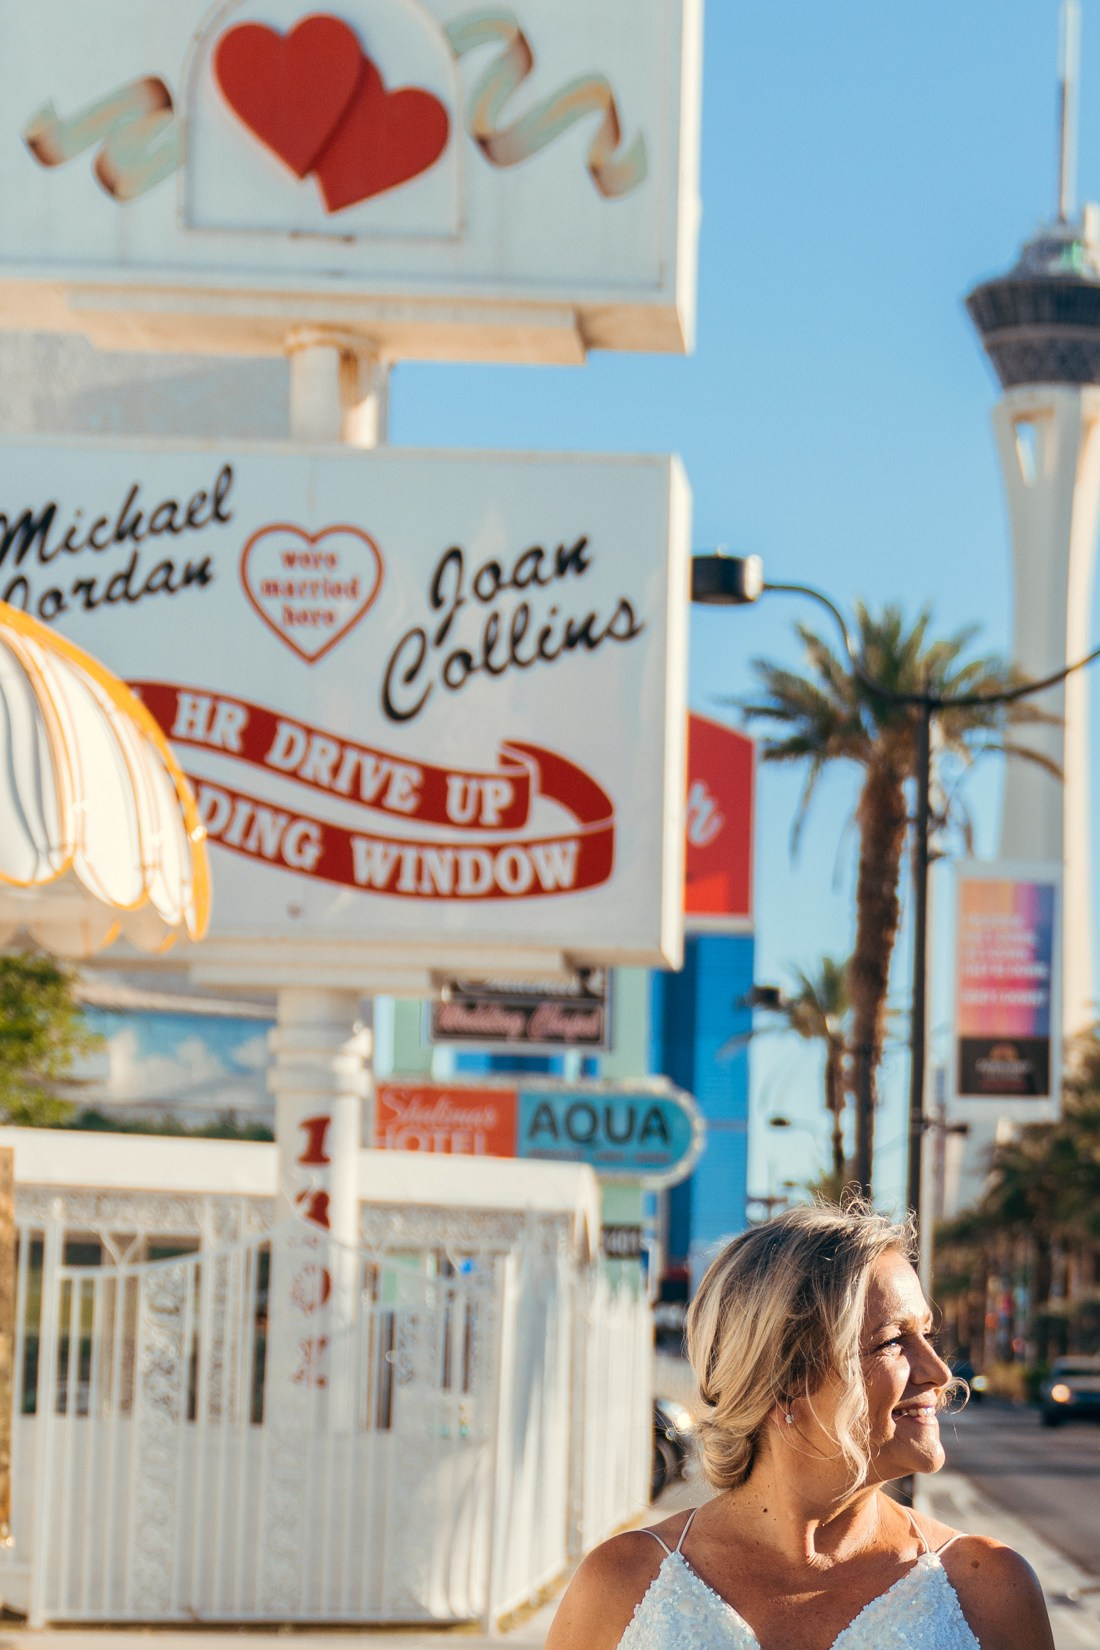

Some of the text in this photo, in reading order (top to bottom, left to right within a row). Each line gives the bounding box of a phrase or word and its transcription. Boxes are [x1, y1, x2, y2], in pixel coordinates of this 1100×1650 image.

[0, 463, 233, 566] Michael
[261, 576, 359, 599] married
[283, 603, 337, 627] here
[430, 534, 592, 648] Joan
[381, 597, 645, 724] Collins
[171, 690, 515, 826] HR DRIVE UP
[199, 784, 579, 895] DING WINDOW
[527, 1102, 671, 1147] AQUA
